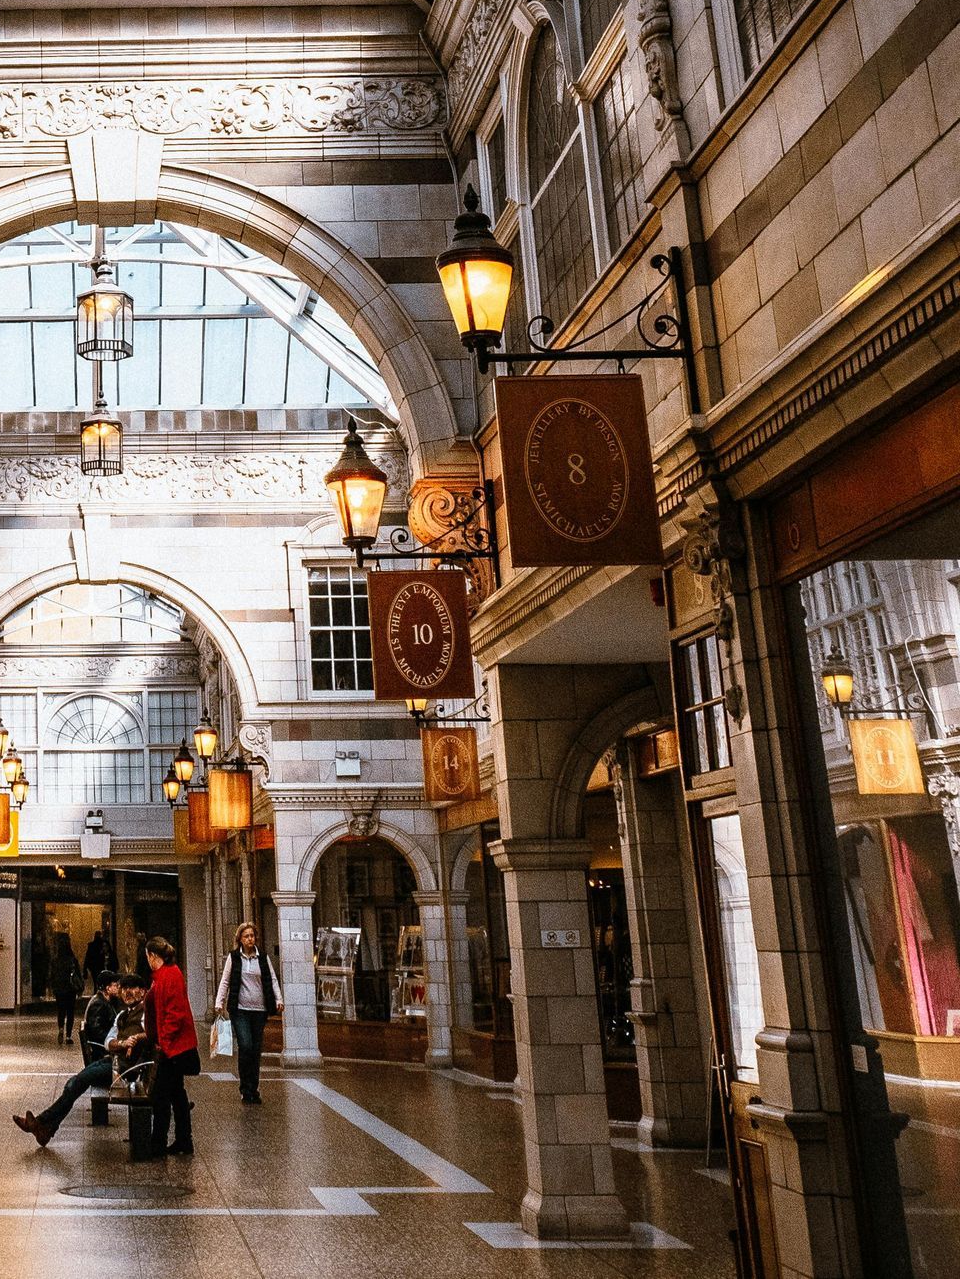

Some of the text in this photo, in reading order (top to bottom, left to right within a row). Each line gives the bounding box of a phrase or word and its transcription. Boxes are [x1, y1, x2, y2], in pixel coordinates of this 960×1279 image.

[529, 403, 621, 464] JEWELLERY BY DESIGN
[567, 453, 587, 485] 8
[608, 480, 623, 512] ROW
[390, 612, 401, 634] THE
[413, 584, 451, 634] EMPORIUM
[411, 623, 434, 645] 10
[390, 637, 451, 685] ST MICHAELS ROW
[443, 754, 460, 771] 14
